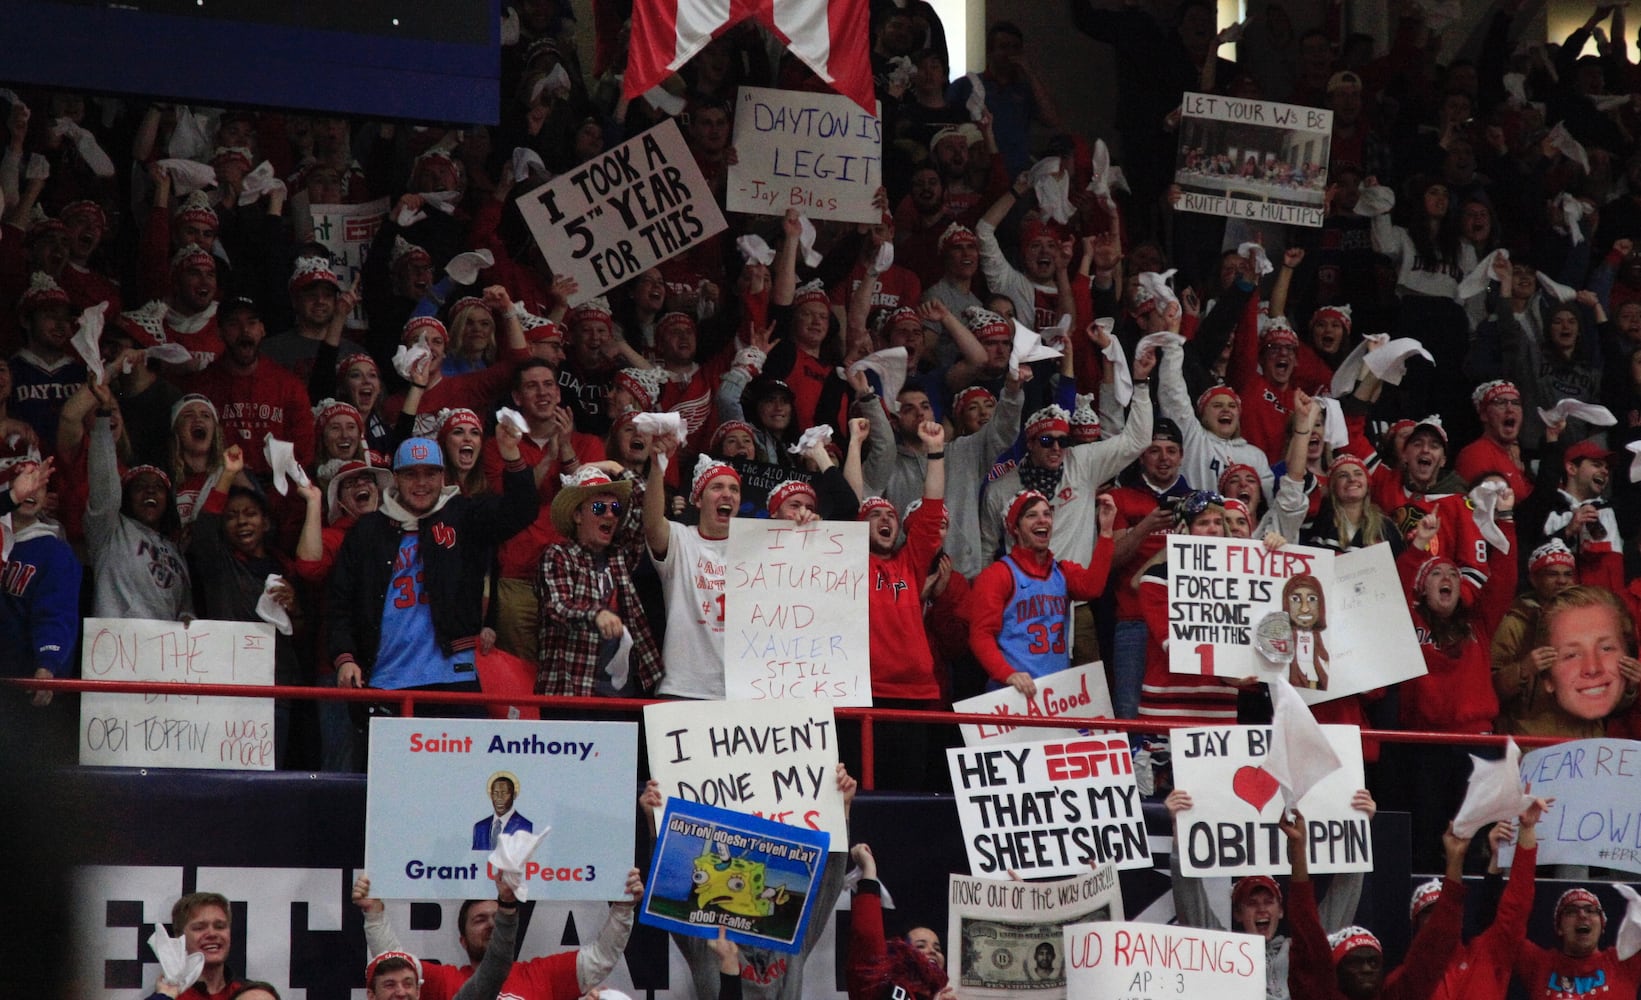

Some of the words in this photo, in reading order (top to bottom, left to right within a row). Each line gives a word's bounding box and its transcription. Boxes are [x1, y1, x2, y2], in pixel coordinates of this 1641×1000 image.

[1186, 96, 1216, 115] LET
[1225, 101, 1265, 120] YOUR
[1307, 110, 1326, 130] BE
[537, 189, 565, 225] I
[571, 144, 640, 205] TOOK
[642, 133, 668, 171] A
[607, 166, 692, 230] YEAR
[790, 187, 837, 211] Bilas
[1183, 193, 1243, 215] RUITFUL
[1246, 202, 1255, 216] &
[1260, 203, 1324, 225] MULTIPLY
[589, 240, 641, 288] FOR
[639, 204, 704, 260] THIS
[17, 382, 82, 403] DAYTO
[767, 527, 844, 555] IT'S
[1172, 543, 1217, 572] THE
[1226, 545, 1315, 578] FLYERS
[735, 563, 866, 601] SATURDAY
[1175, 575, 1239, 600] FORCE
[1248, 580, 1272, 602] IS
[750, 604, 815, 630] AND
[1169, 601, 1251, 625] STRONG
[741, 630, 849, 661] XAVIER
[1027, 623, 1066, 655] 33
[1172, 624, 1220, 643] WITH
[1223, 626, 1251, 645] THIS
[91, 627, 137, 675] ON
[148, 630, 210, 675] THE
[1194, 644, 1215, 675] 1
[766, 660, 831, 680] STILL
[750, 675, 858, 701] SUCKS!
[1043, 674, 1091, 716] Good
[87, 716, 129, 753] OBI
[134, 717, 210, 754] TOPPIN
[410, 733, 472, 753] Saint
[488, 734, 600, 761] Anthony,
[665, 729, 691, 763] I
[709, 717, 829, 758] HAVEN'T
[1184, 730, 1231, 758] JAY
[957, 748, 1031, 789] HEY
[1043, 739, 1133, 782] ESPN
[678, 772, 754, 808] DONE
[772, 765, 825, 804] MY
[970, 786, 1084, 829] THAT'S
[1088, 785, 1136, 819] MY
[974, 821, 1150, 874] SHEETSIGN
[1189, 822, 1255, 869] OBI
[1259, 819, 1369, 868] TPPIN
[405, 860, 478, 881] Grant
[525, 861, 596, 882] Peac3
[1012, 886, 1026, 910] of
[1031, 885, 1055, 911] the
[1070, 931, 1103, 970] UD
[1114, 930, 1255, 977] RANKINGS
[1129, 971, 1153, 993] AP
[1175, 972, 1186, 994] 3
